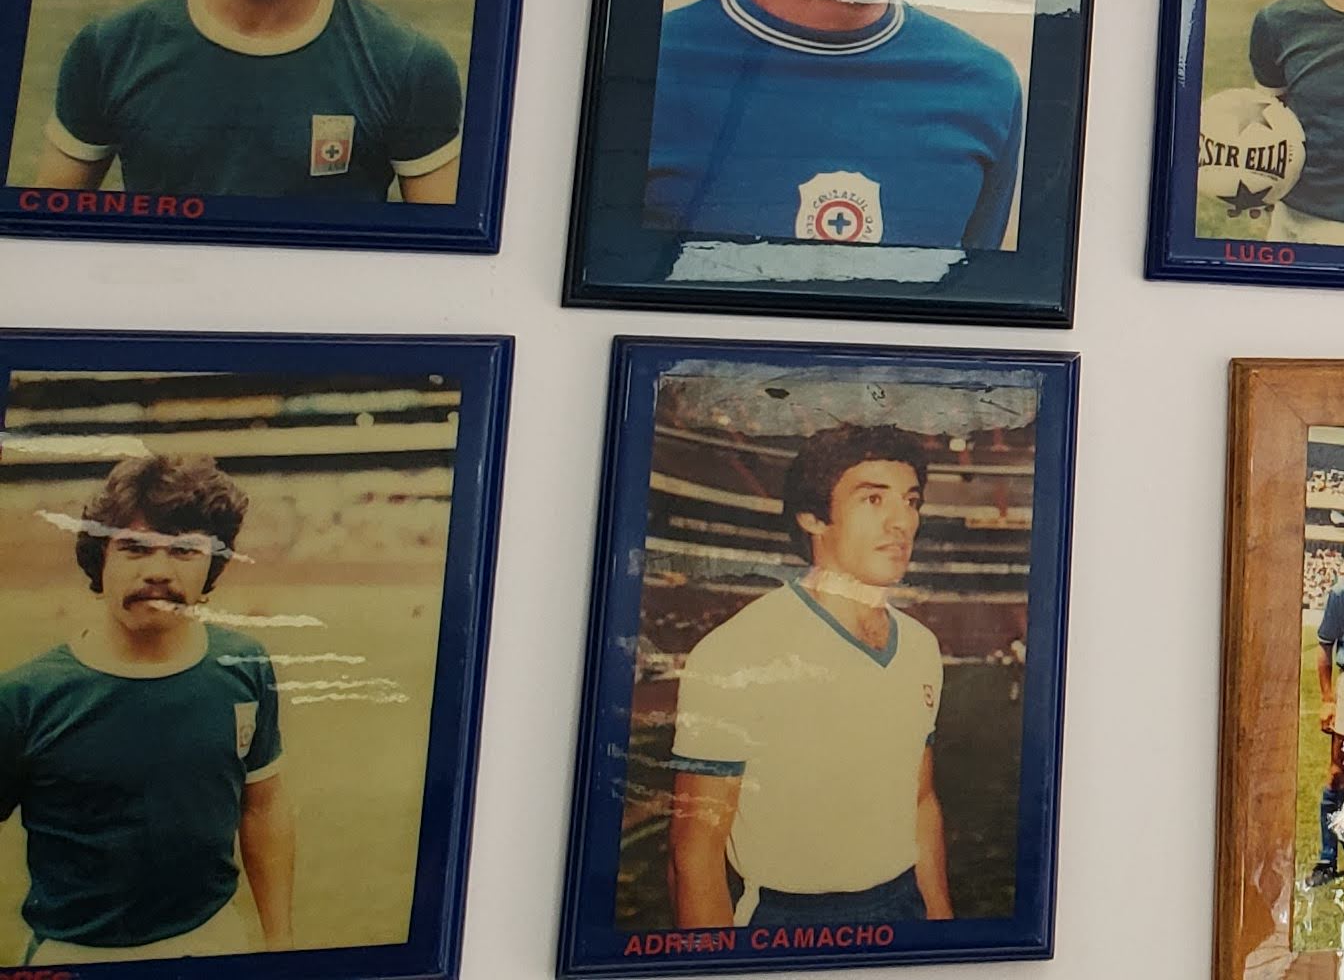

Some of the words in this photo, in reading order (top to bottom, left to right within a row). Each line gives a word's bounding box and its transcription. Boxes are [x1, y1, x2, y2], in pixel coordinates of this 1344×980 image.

[19, 190, 205, 219] CORNERO
[1225, 243, 1296, 265] LUGO
[624, 930, 737, 956] ADRIAN
[751, 924, 895, 950] CAMACHO
